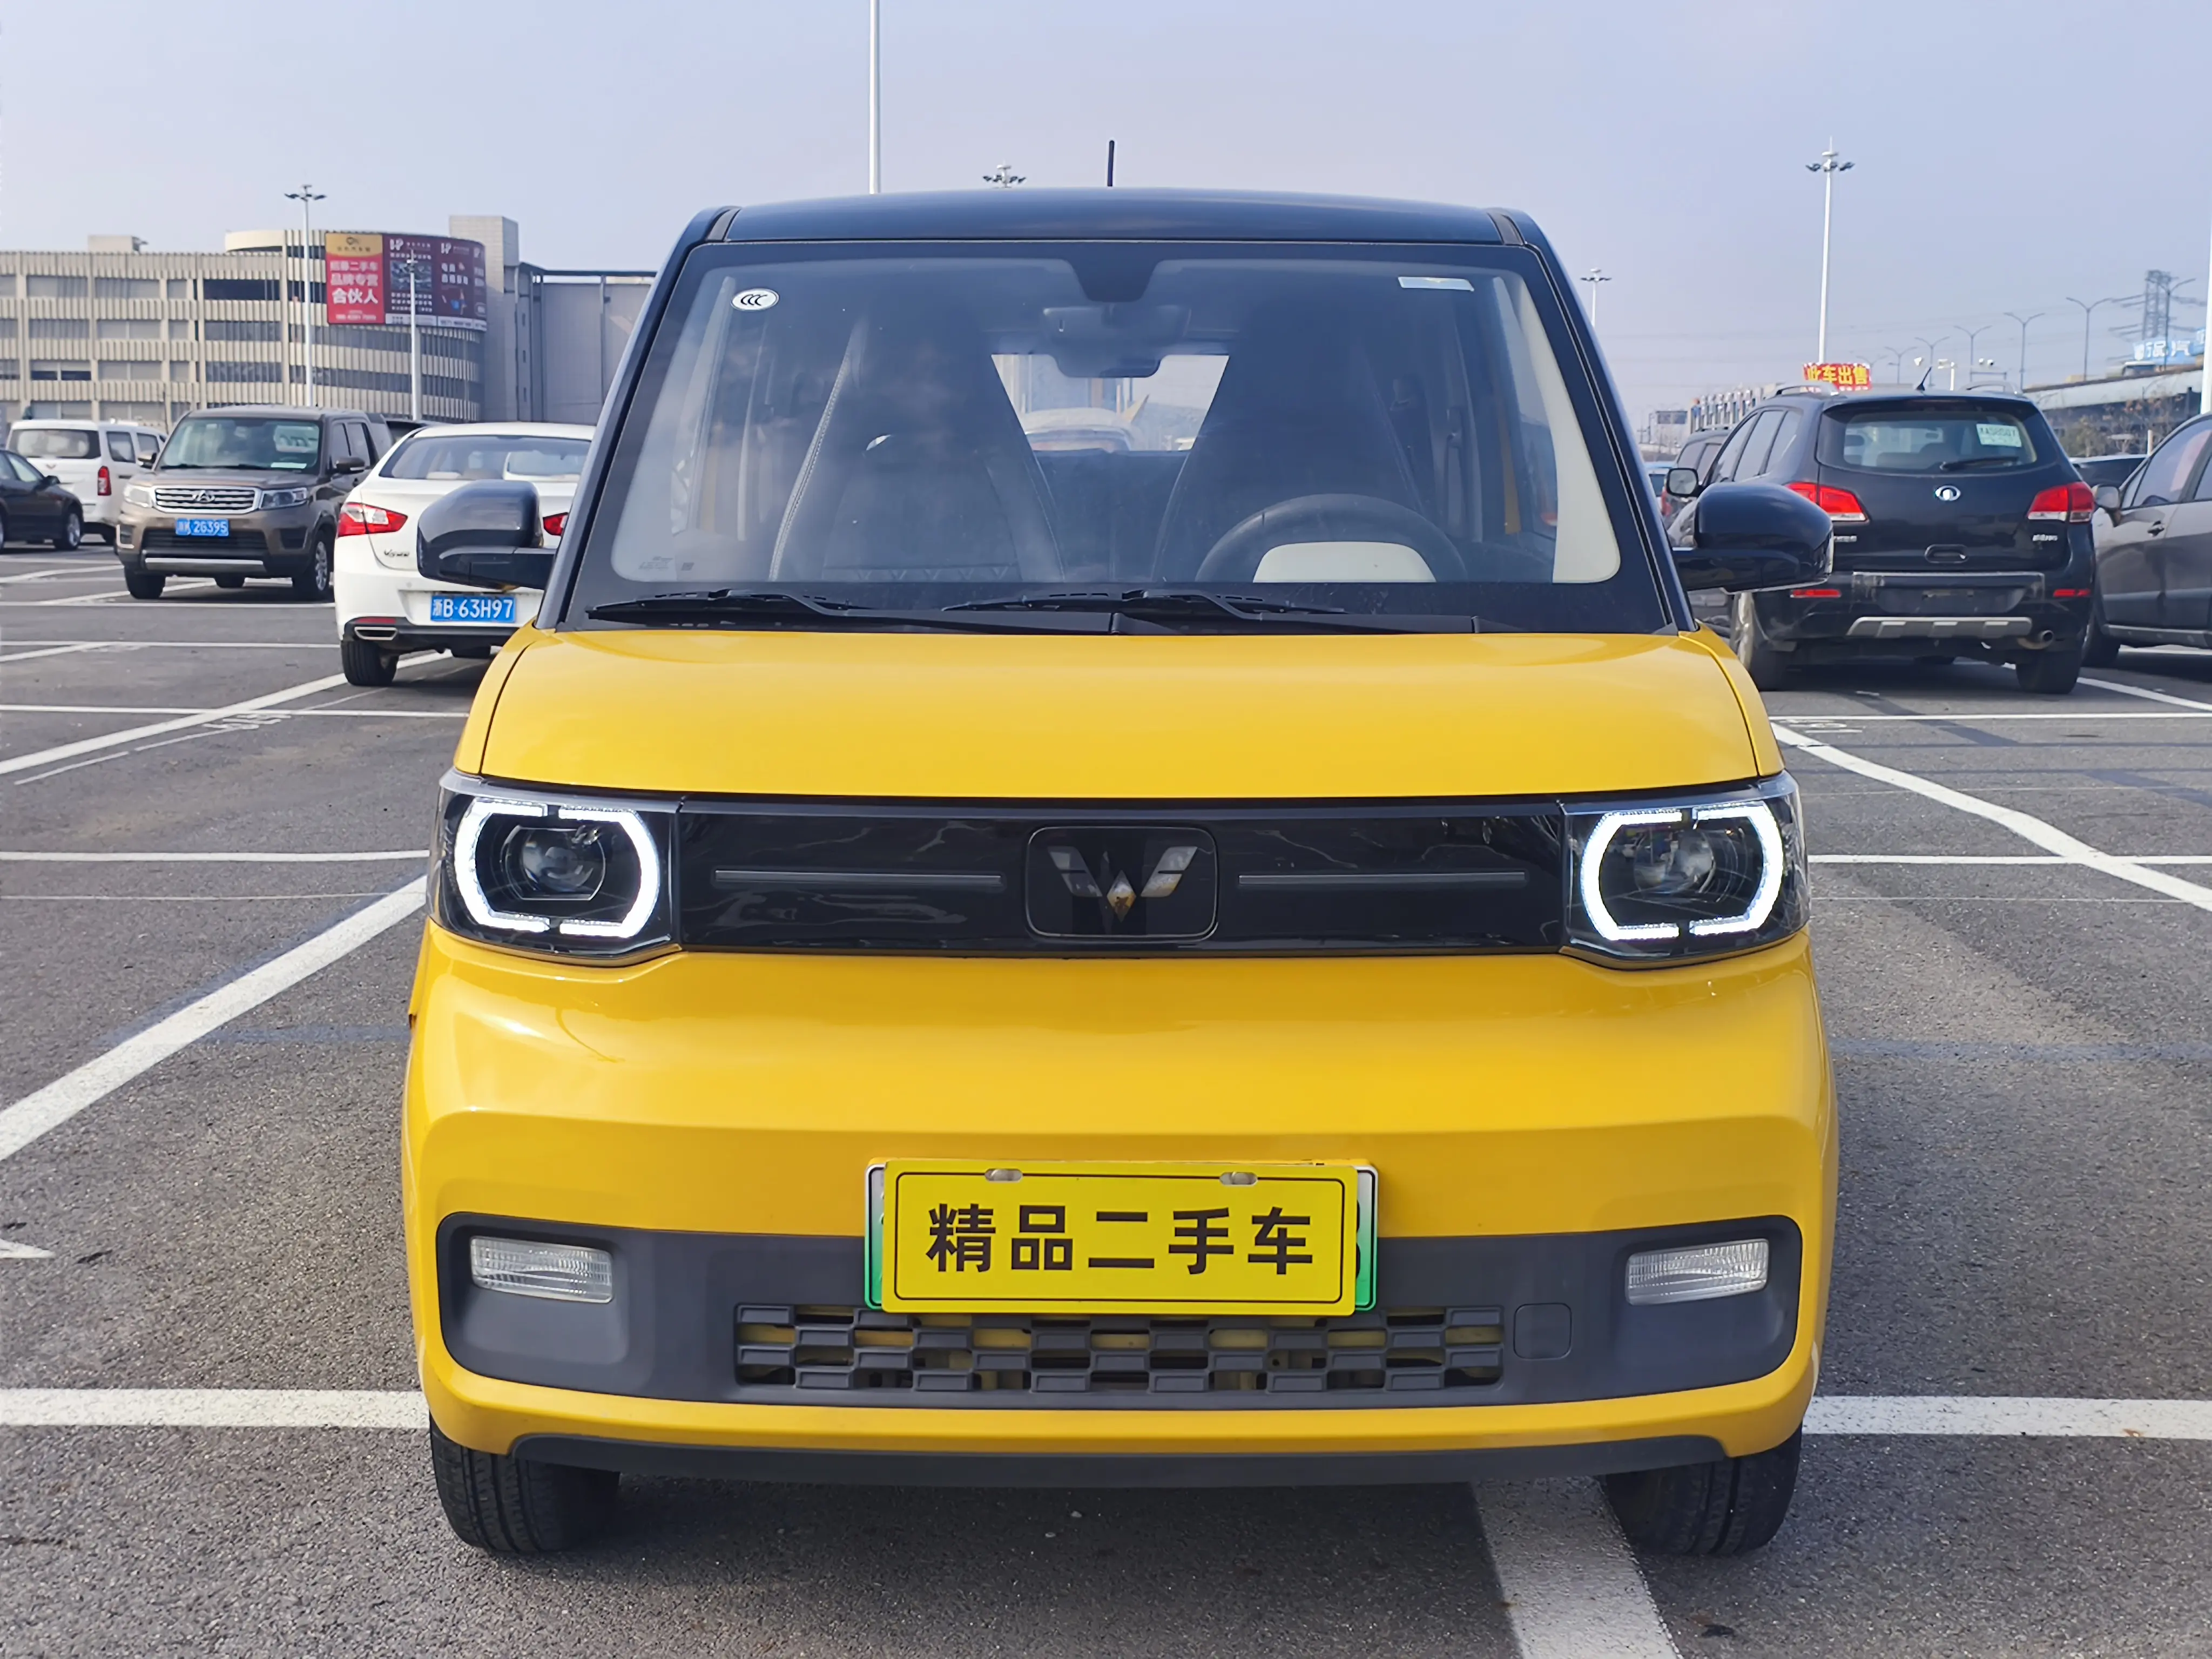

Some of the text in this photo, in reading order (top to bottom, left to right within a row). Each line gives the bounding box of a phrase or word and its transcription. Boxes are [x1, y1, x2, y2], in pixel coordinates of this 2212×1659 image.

[332, 288, 378, 304] 合伙人
[925, 1203, 1313, 1276] 精品二手车
